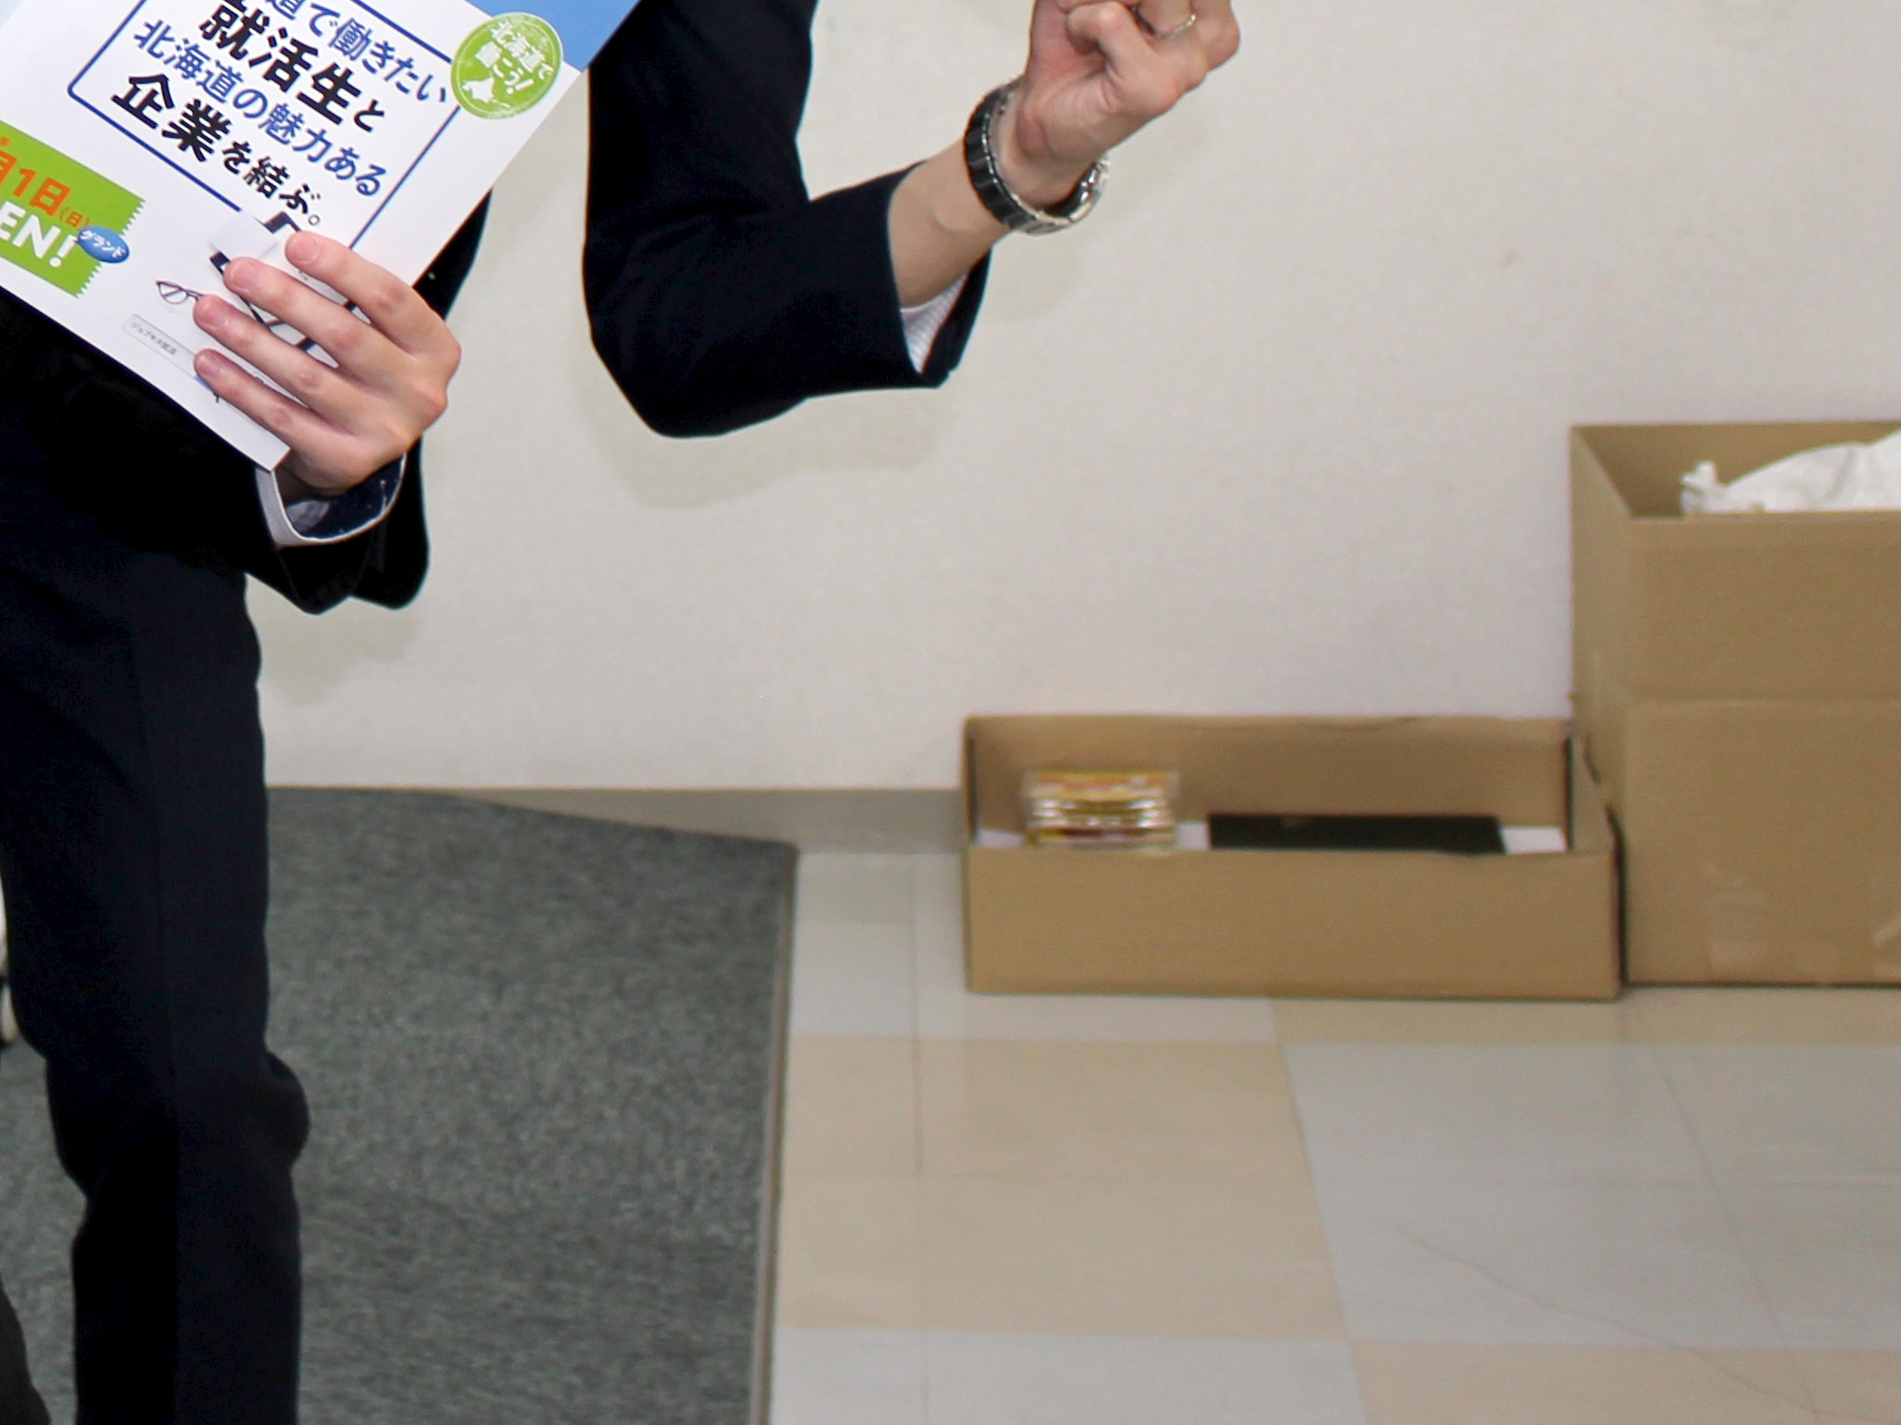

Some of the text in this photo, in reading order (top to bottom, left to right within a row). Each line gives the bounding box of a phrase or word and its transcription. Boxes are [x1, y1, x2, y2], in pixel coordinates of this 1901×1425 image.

[490, 21, 554, 80] 北海道で
[111, 72, 321, 226] 企業を結ぶ。
[133, 19, 387, 197] 北海道の魅力ある
[79, 228, 127, 259] グランド
